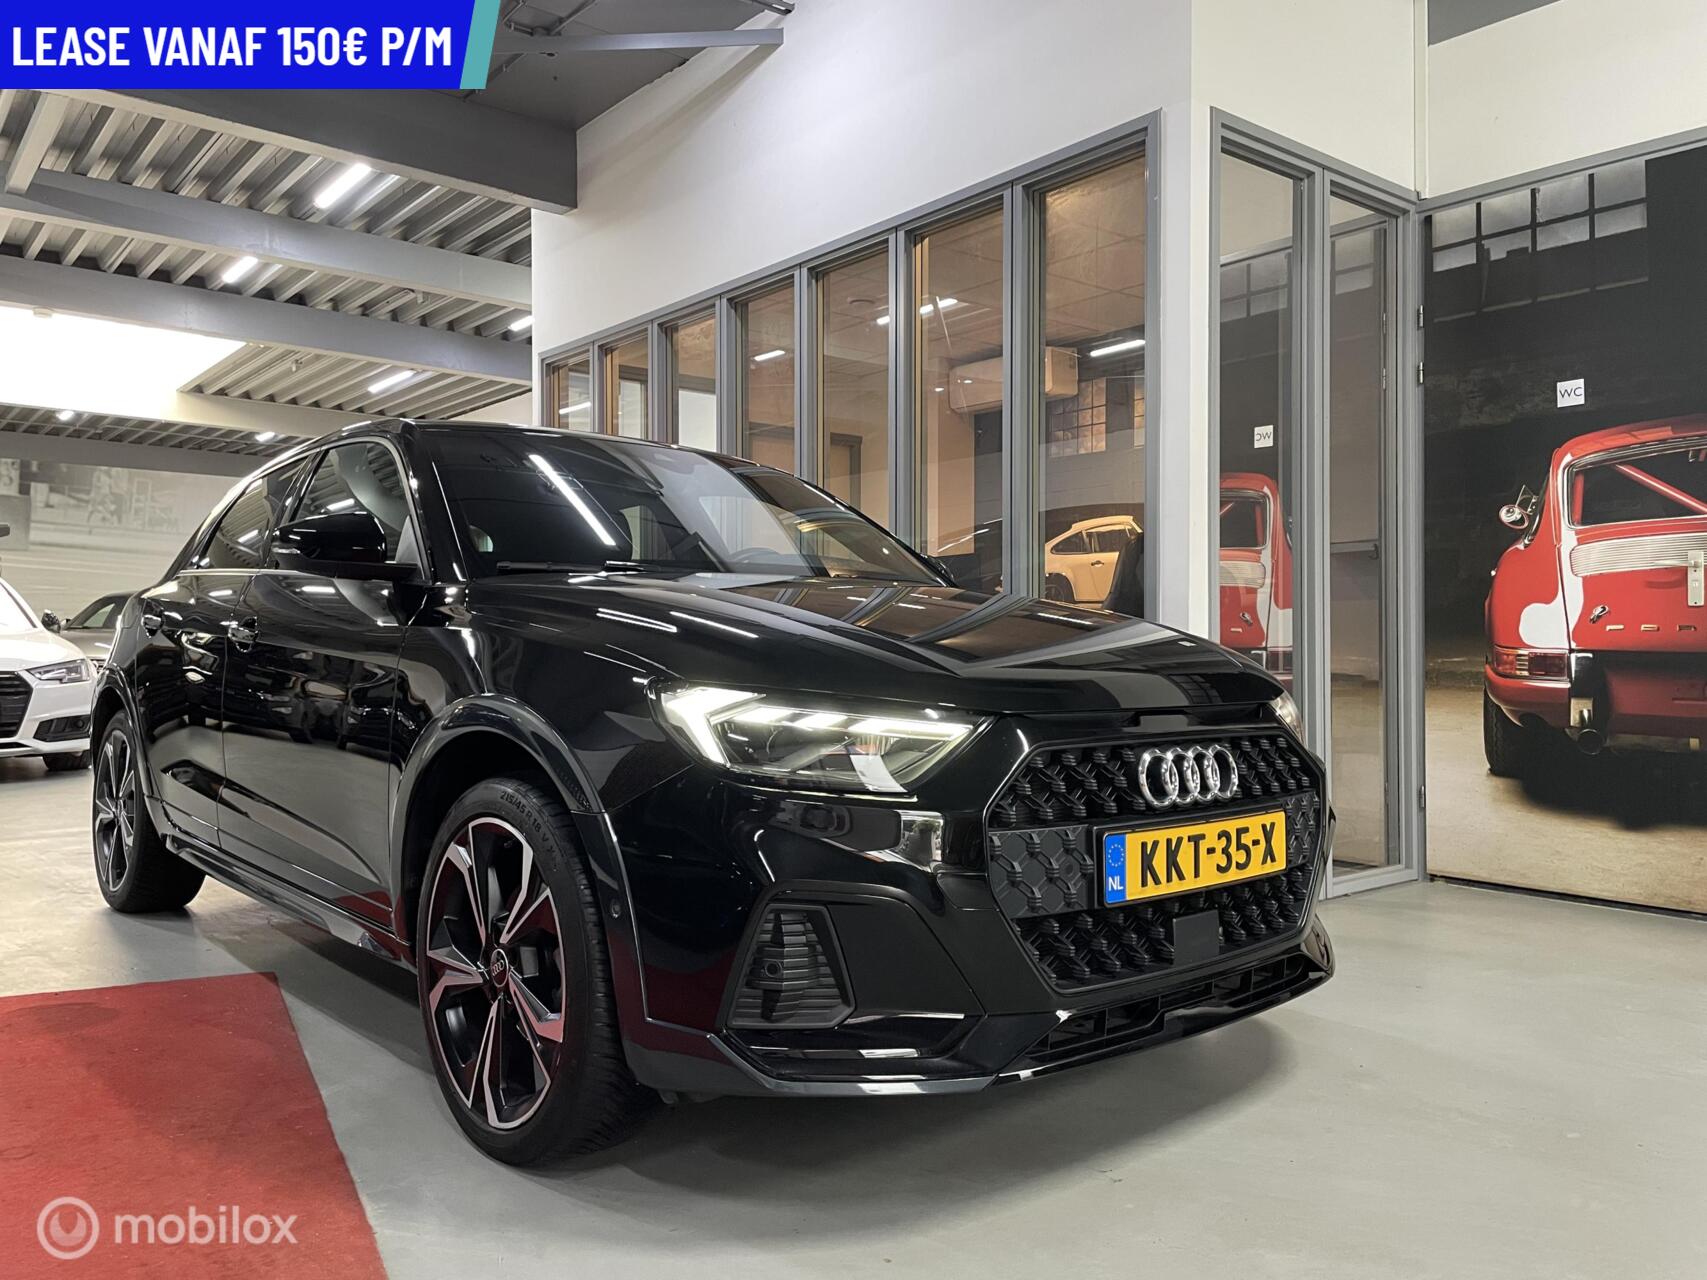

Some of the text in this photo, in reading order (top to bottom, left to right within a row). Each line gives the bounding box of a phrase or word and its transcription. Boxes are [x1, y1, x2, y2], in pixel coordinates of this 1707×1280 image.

[1559, 386, 1583, 398] WC
[500, 790, 527, 814] 215/45
[531, 818, 542, 833] 18
[1140, 821, 1277, 888] KKT-35-X
[1108, 876, 1124, 892] NL
